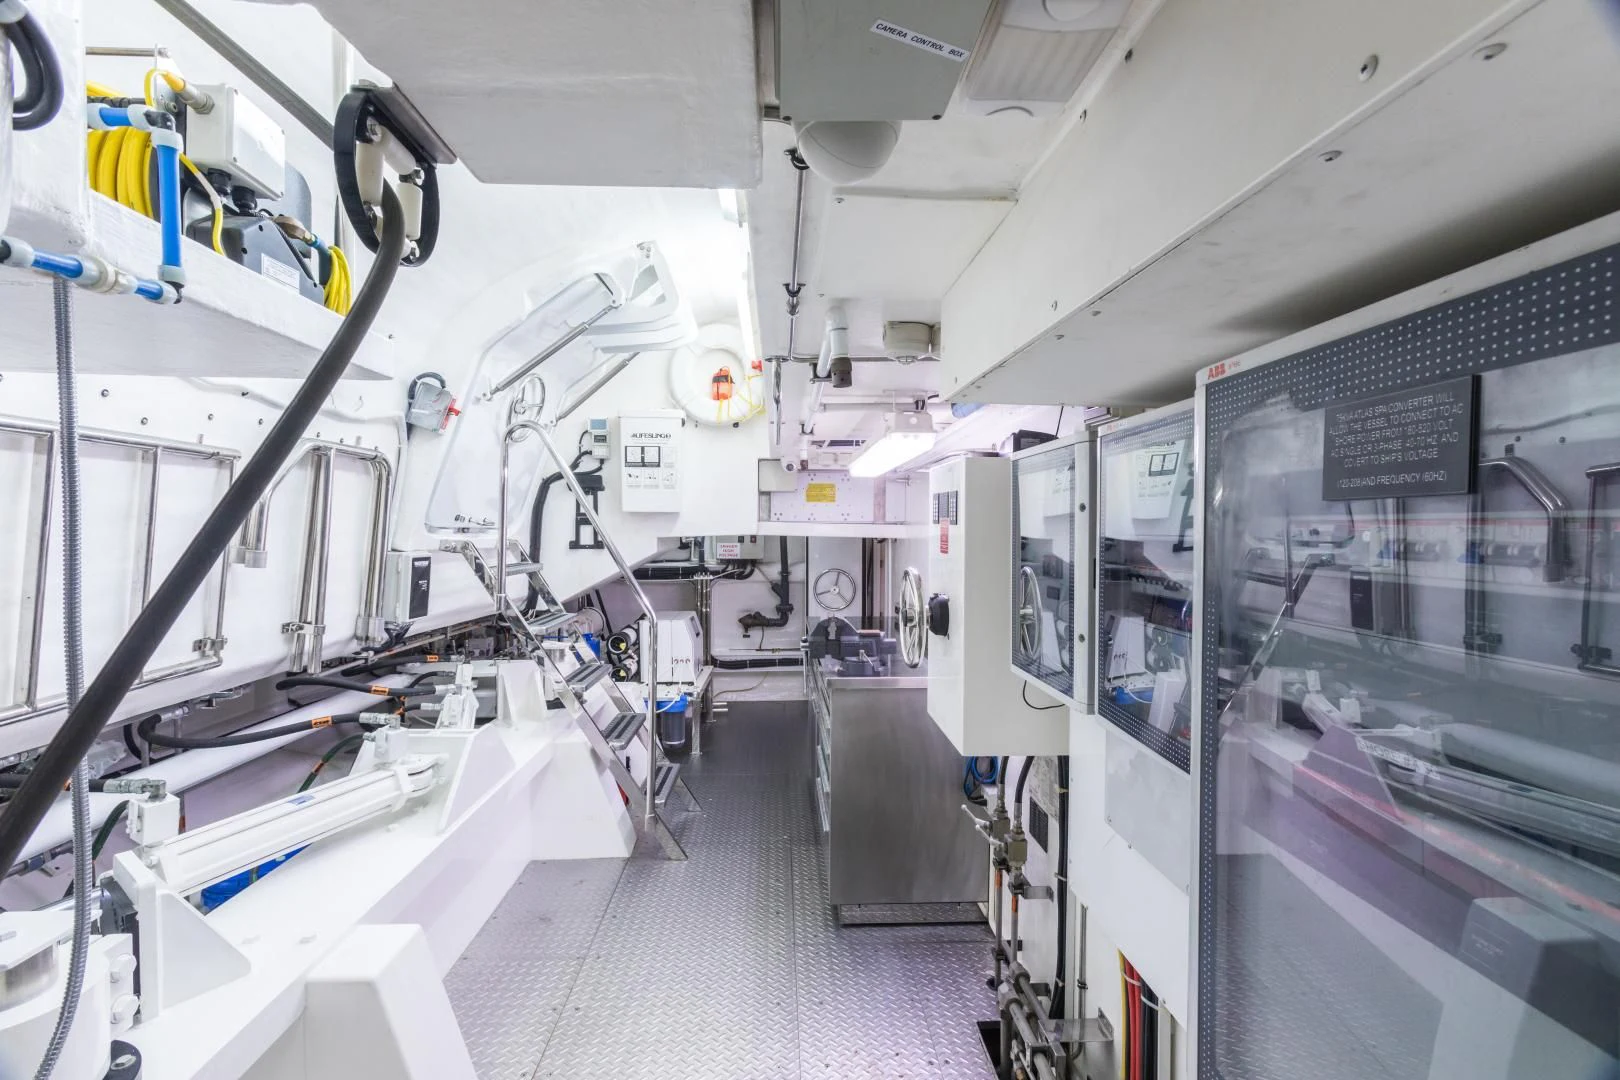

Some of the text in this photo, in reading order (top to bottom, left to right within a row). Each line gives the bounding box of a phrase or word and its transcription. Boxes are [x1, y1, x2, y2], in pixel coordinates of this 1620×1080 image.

[875, 23, 965, 58] CAMERA CONTROL BOX
[1208, 363, 1226, 380] ABB
[1355, 407, 1373, 419] ATLAS
[1387, 395, 1434, 413] CONVERTER
[1435, 391, 1455, 404] WILL
[1364, 417, 1388, 429] VESSEL
[1390, 415, 1400, 425] TO
[1400, 407, 1438, 424] CONNECT
[1440, 405, 1451, 416] TO
[1452, 402, 1464, 414] AC
[1335, 434, 1356, 446] SHORE
[1382, 427, 1403, 439] FROM
[1433, 418, 1454, 431] VOLT
[1440, 431, 1459, 443] AND
[1370, 455, 1380, 466] TO
[1404, 447, 1439, 462] VOLTAGE
[1376, 472, 1420, 485] FREQUENCY
